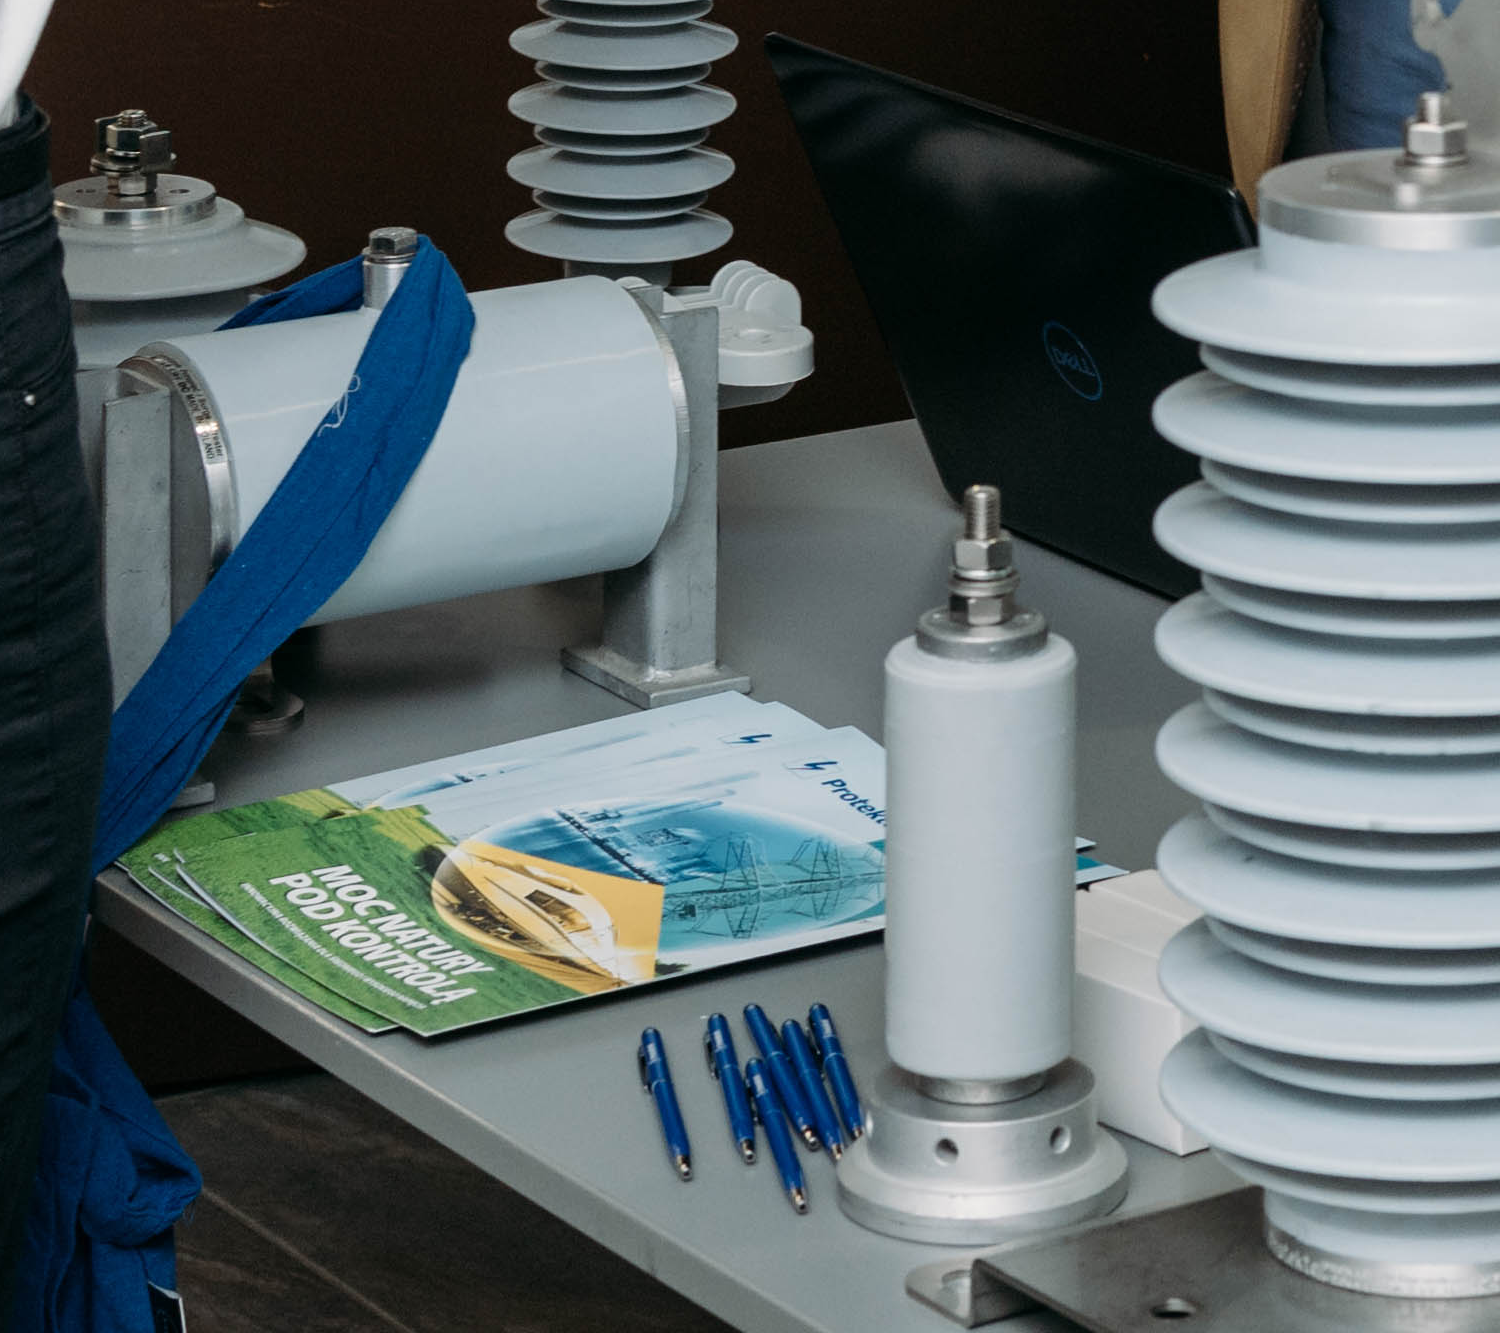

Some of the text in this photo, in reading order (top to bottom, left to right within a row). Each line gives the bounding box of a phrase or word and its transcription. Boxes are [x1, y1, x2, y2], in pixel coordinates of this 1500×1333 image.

[269, 872, 346, 921] POD
[311, 864, 397, 917] MOC
[369, 912, 496, 976] NATURY
